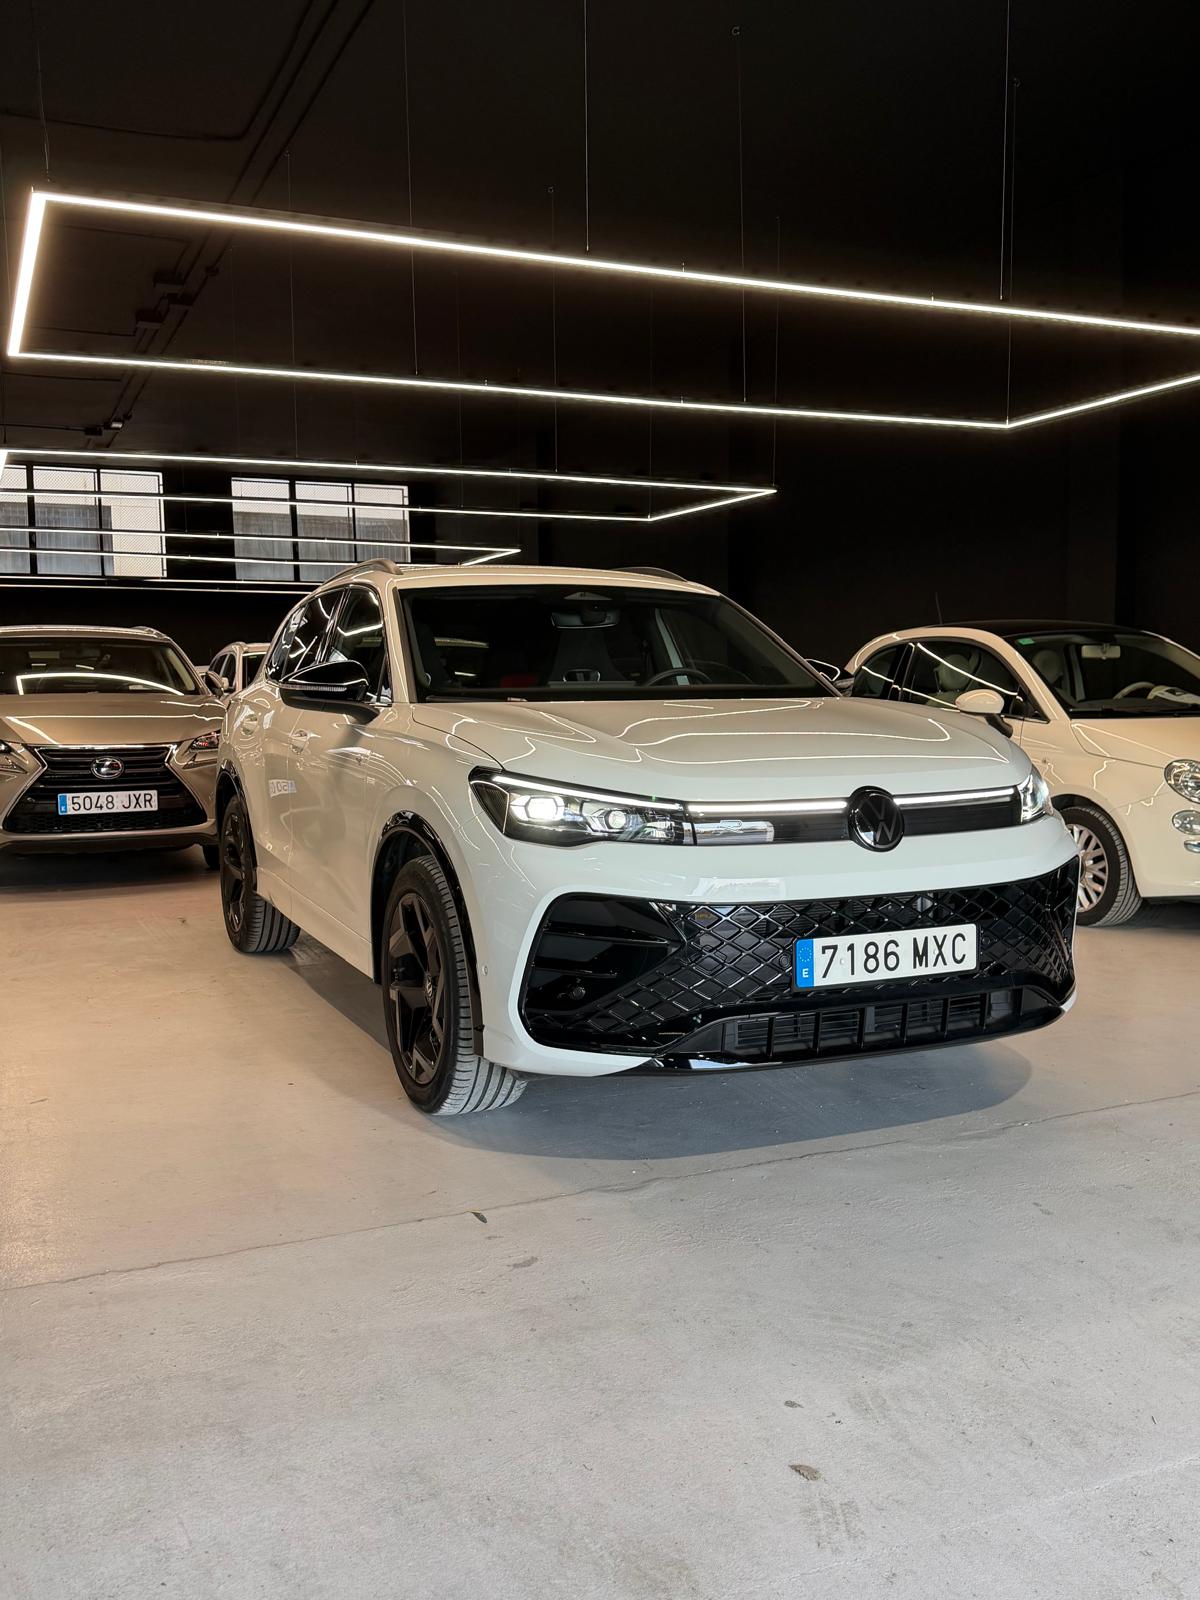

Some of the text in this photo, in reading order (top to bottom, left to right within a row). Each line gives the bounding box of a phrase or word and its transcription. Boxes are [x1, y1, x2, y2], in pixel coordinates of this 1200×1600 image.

[71, 793, 153, 811] 5048 JXR
[821, 932, 967, 979] 7186 MXC
[802, 968, 809, 978] E
